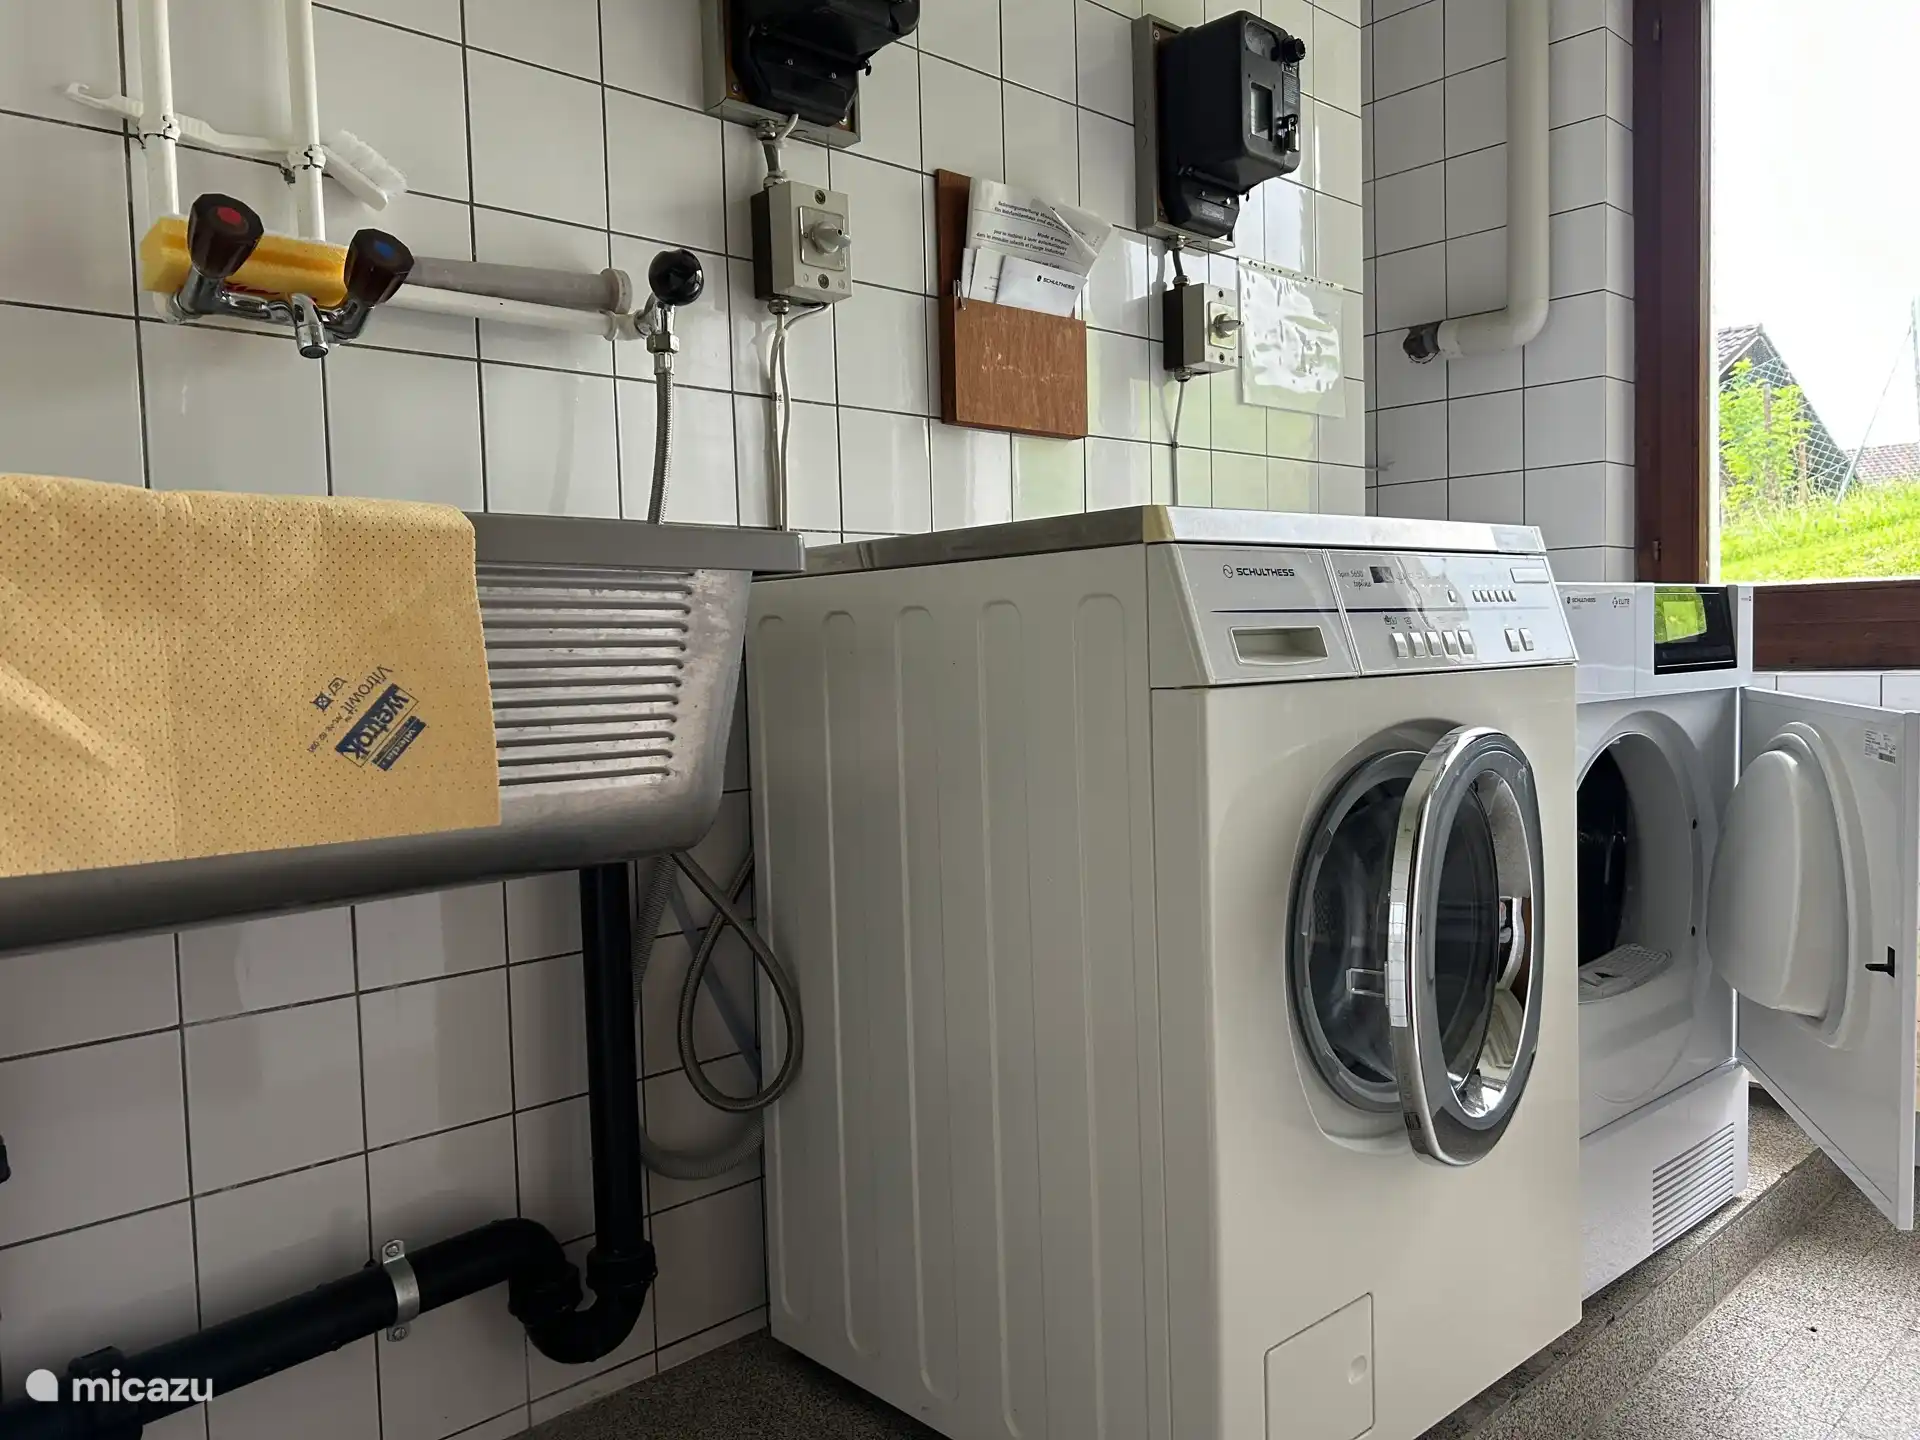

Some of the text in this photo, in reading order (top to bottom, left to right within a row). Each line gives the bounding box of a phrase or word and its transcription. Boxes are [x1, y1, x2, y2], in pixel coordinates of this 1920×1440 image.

[1043, 277, 1076, 290] SCHULTHESS
[1236, 567, 1295, 577] SCHULTHESS
[384, 726, 418, 762] vileda
